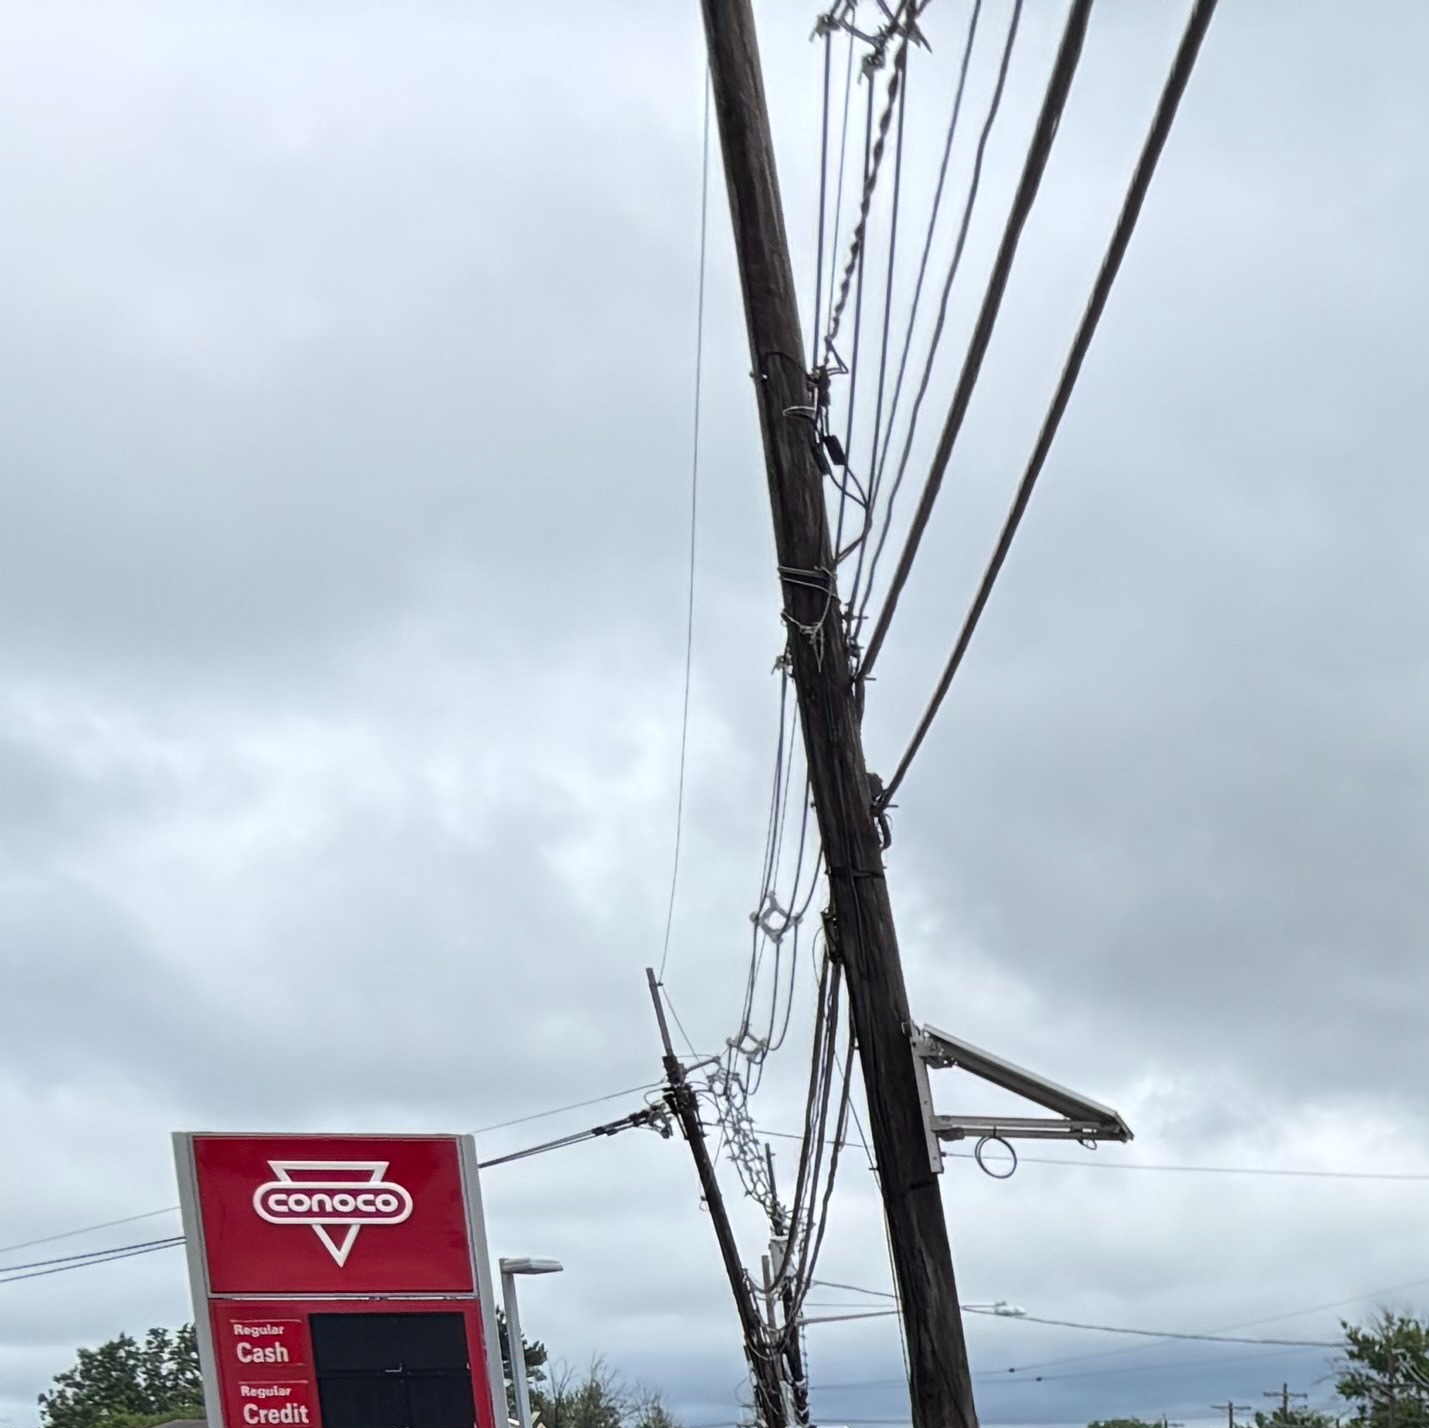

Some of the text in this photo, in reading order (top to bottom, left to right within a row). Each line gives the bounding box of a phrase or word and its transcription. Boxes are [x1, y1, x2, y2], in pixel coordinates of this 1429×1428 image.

[233, 1324, 285, 1338] Regular
[236, 1341, 290, 1363] Cash
[240, 1385, 292, 1399] Regular
[242, 1402, 310, 1424] Credit
